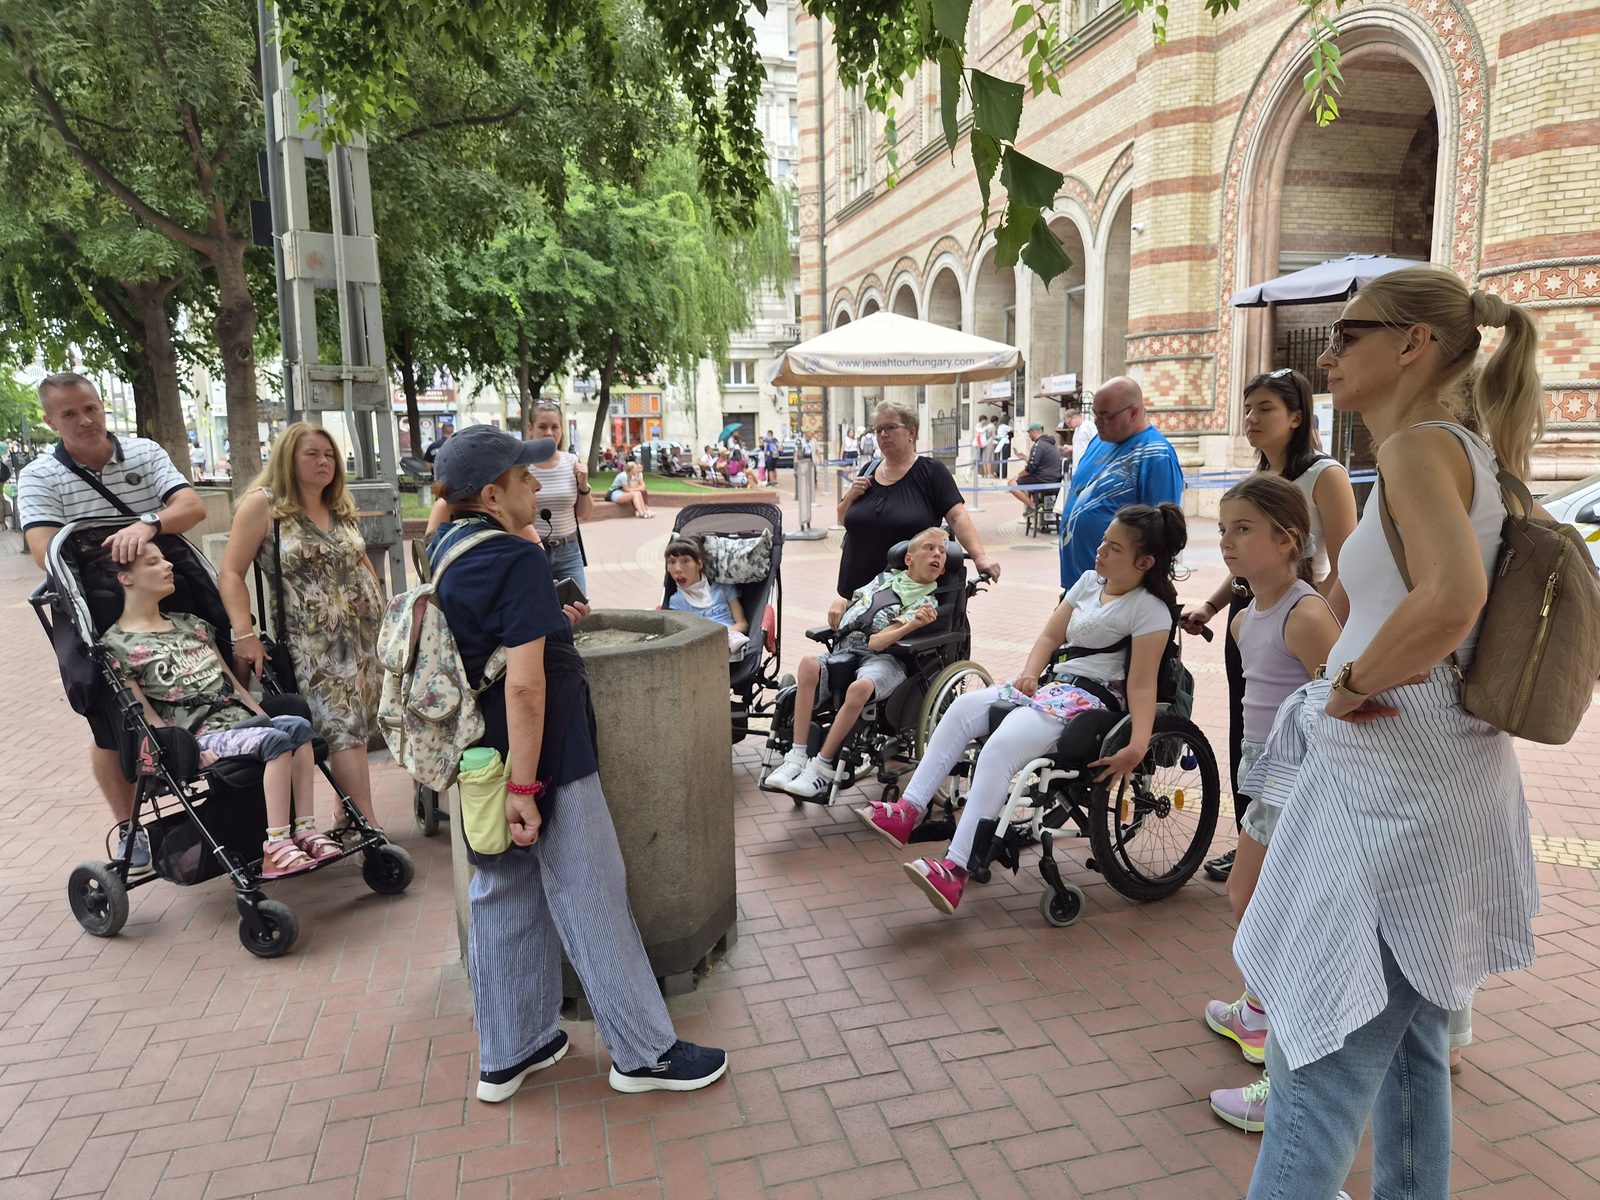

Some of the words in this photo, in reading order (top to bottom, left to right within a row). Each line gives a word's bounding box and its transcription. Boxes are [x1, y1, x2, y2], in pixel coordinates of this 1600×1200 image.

[836, 358, 975, 369] www.jewishtourhungary.com
[155, 644, 214, 686] California
[182, 673, 204, 686] OAK
